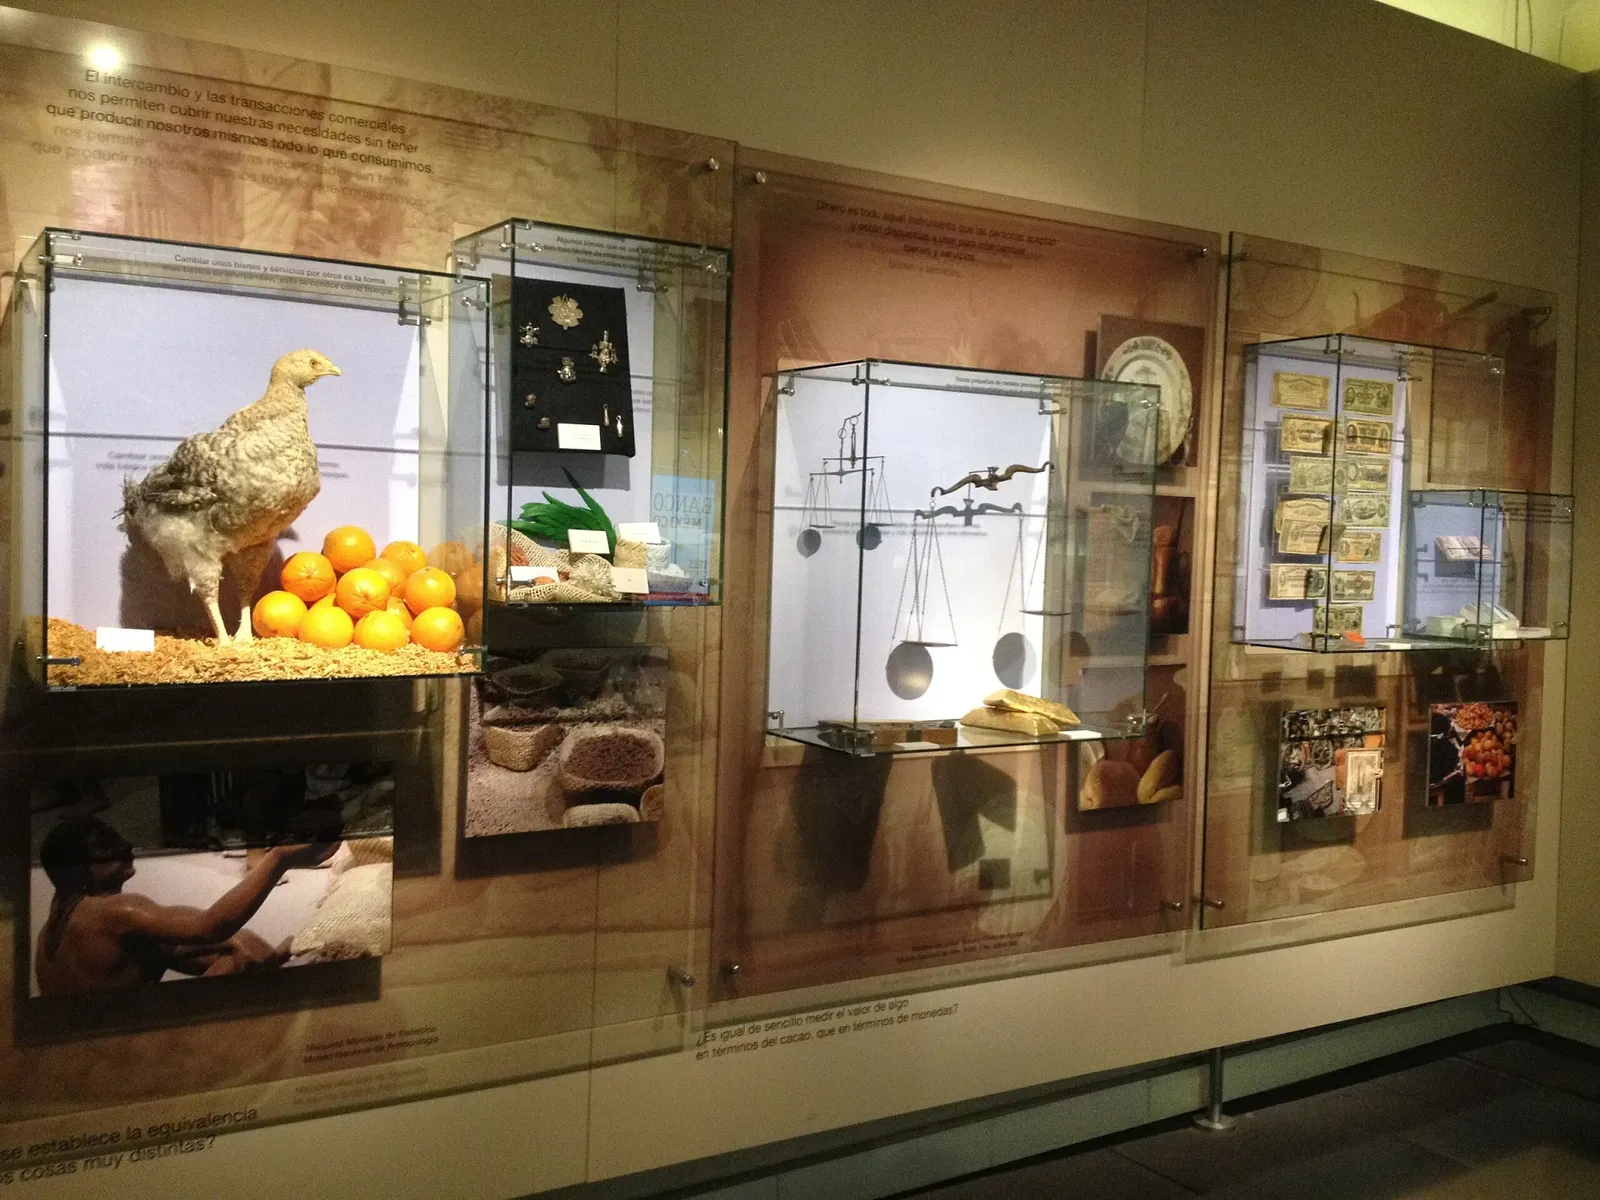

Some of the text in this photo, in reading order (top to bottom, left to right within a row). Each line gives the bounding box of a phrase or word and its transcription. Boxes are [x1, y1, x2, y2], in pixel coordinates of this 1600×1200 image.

[68, 88, 419, 154] nos permiten cubrir nuestras necesidades sin tener
[85, 69, 406, 135] El intercambio y las transacciones comerciales
[46, 104, 75, 117] que
[80, 109, 142, 128] producir
[146, 118, 210, 138] nosotros
[213, 127, 268, 147] mismos
[271, 138, 303, 153] todo
[307, 142, 318, 155] lo
[323, 147, 348, 160] que
[352, 150, 435, 174] consumimos.
[174, 254, 210, 266] Cambiar
[211, 258, 233, 268] unos
[233, 260, 262, 271] bienes
[269, 264, 305, 276] servicios
[306, 268, 321, 278] por
[321, 271, 342, 280] otros
[343, 274, 354, 282] es
[362, 274, 386, 285] forma
[695, 1050, 710, 1061] en
[712, 1039, 759, 1058] términos
[761, 1035, 778, 1048] del
[816, 1028, 836, 1040] que
[838, 1024, 851, 1034] en
[852, 1016, 895, 1031] términos
[896, 1013, 909, 1024] de
[910, 1003, 959, 1021] monedas?
[696, 998, 909, 1047] ¿Es igual de sencillo medir el valor de algo
[0, 1107, 257, 1162] se establece la equivalencia
[20, 1160, 77, 1183] cosas
[82, 1153, 123, 1175] muy
[129, 1135, 217, 1163] distintas?
